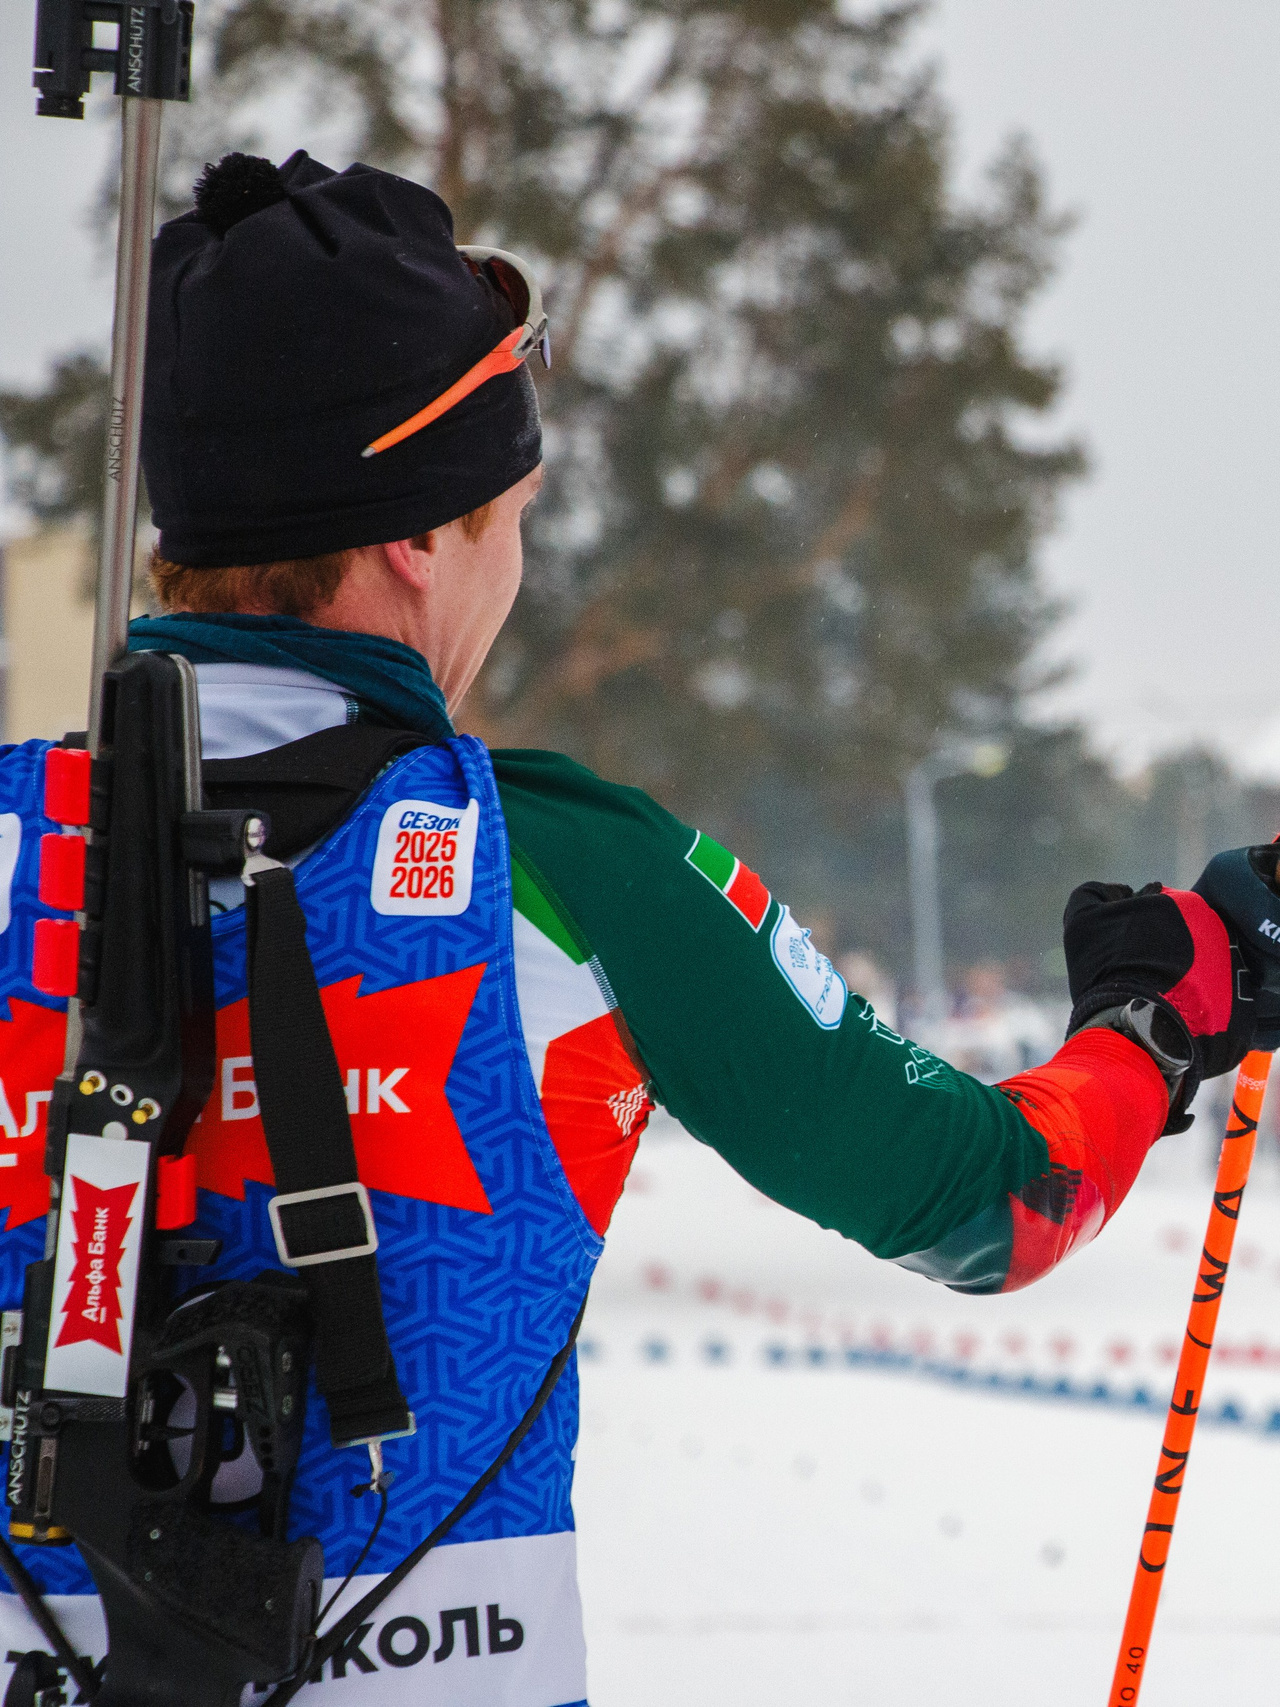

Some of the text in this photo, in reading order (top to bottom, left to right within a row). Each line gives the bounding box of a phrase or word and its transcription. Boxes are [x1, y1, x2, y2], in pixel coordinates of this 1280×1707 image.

[127, 7, 145, 92] ANSCHUTZ
[393, 831, 458, 864] 2025
[389, 865, 455, 899] 2026
[81, 1206, 109, 1324] Альфа Банк
[7, 1390, 32, 1506] ANSCHUTZ
[1126, 1646, 1145, 1674] 40
